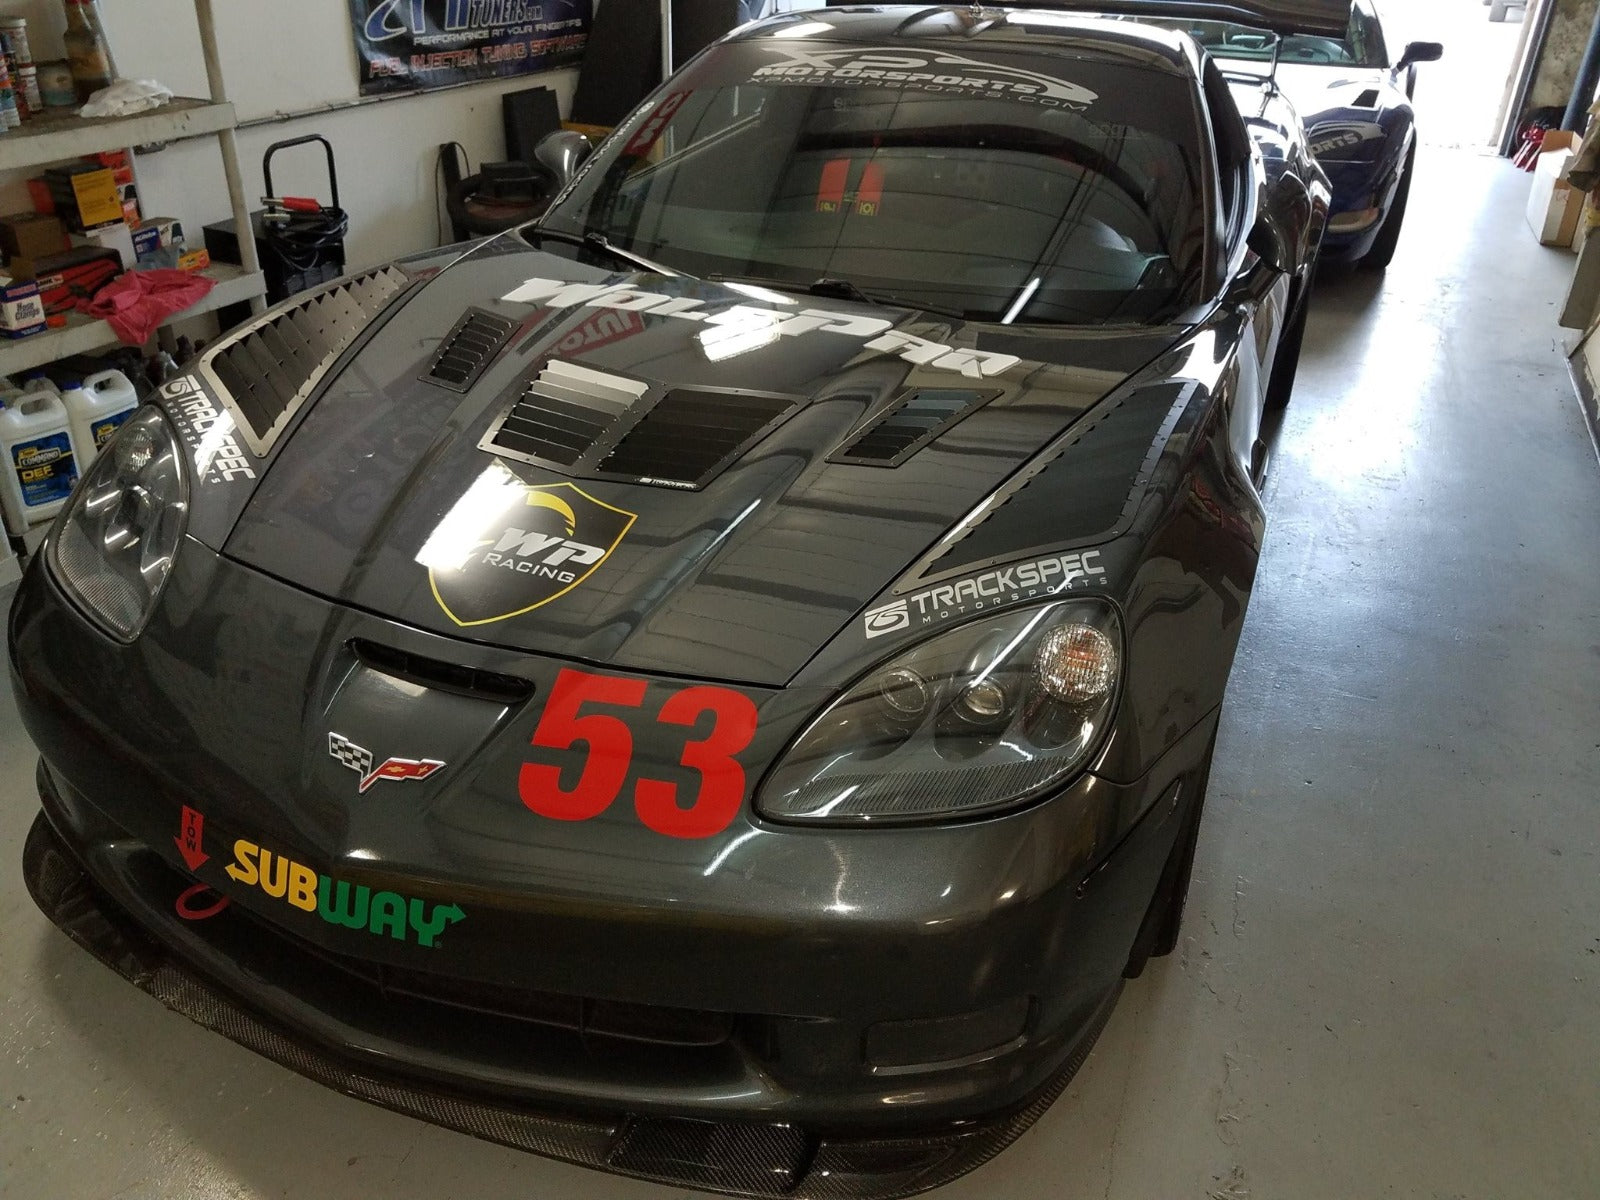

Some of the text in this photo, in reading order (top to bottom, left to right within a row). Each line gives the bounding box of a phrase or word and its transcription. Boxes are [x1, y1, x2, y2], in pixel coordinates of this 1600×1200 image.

[413, 30, 489, 45] PERFORMANCE
[508, 25, 533, 35] YOUR
[410, 48, 478, 74] INJECTION
[753, 66, 1041, 94] MOTORSPORTS
[493, 527, 606, 566] WP
[482, 552, 576, 583] RACING
[911, 550, 1105, 614] TRACKSPEC
[922, 576, 1108, 625] MOTORSPORTS
[518, 667, 759, 840] 53
[186, 812, 197, 852] TOW
[225, 839, 467, 948] SUBWAY
